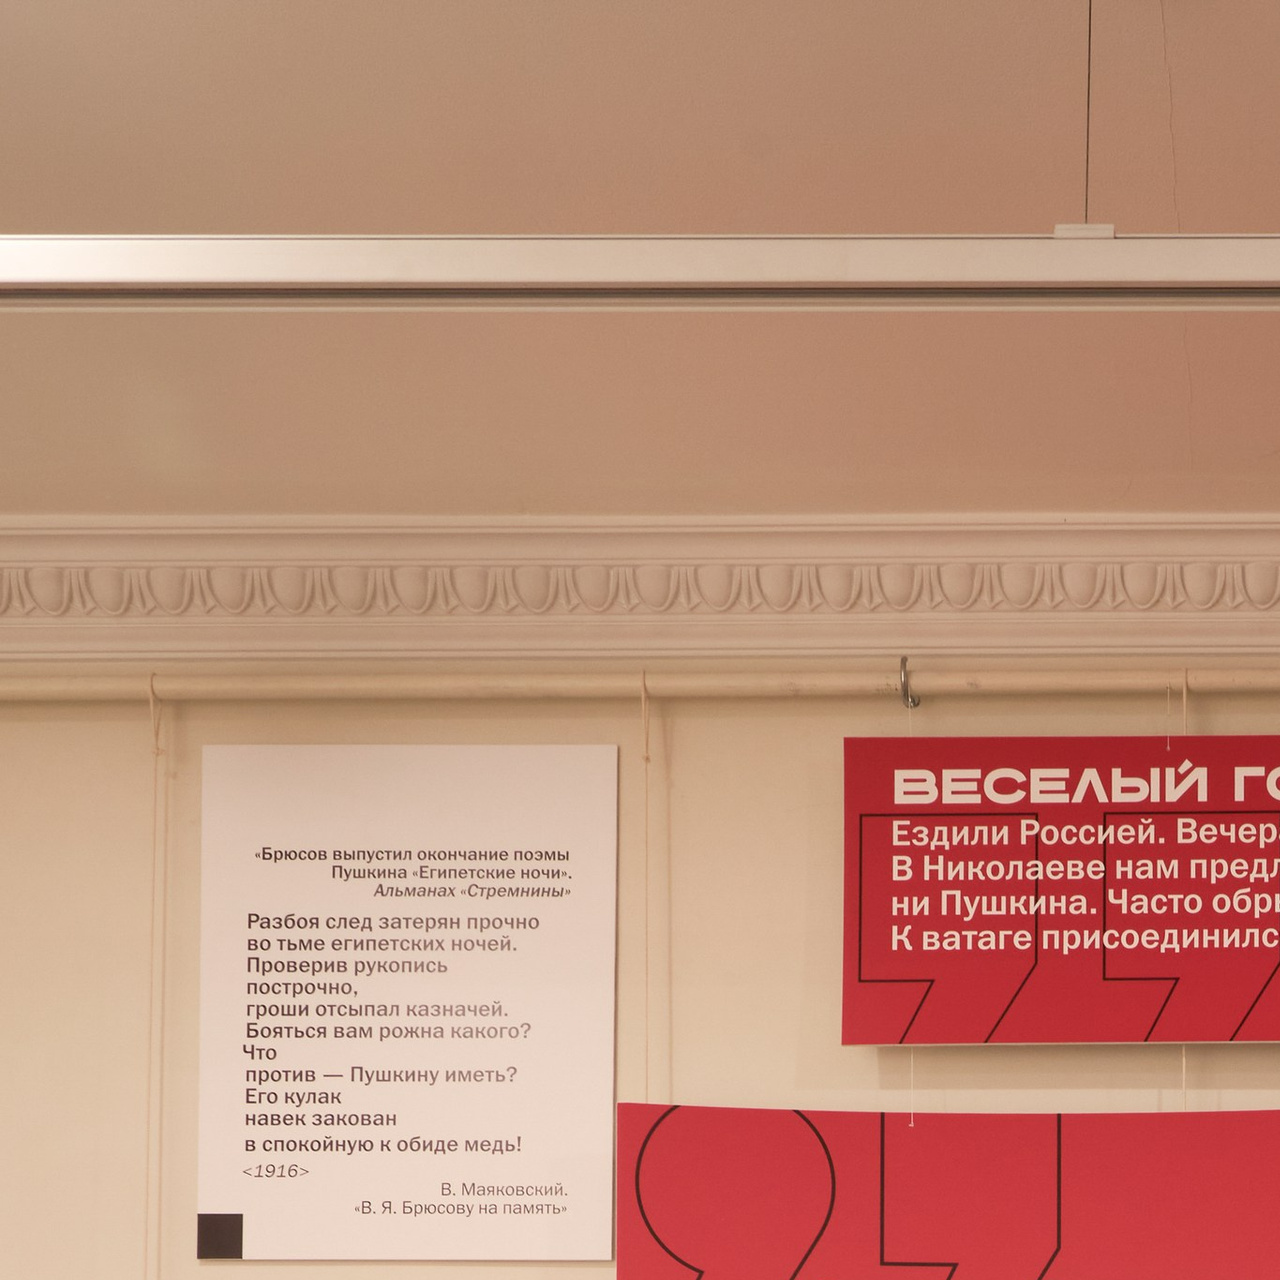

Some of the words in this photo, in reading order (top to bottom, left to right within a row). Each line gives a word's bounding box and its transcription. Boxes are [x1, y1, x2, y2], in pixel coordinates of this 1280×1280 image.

[893, 759, 1208, 805] ВЕСЕЛЫЙ
[892, 820, 1009, 851] Ездили
[1020, 818, 1165, 845] Россией.
[254, 846, 328, 864] «Брюсов
[332, 849, 412, 864] выпустил
[417, 850, 509, 861] окончание
[513, 850, 569, 861] поэмы
[247, 913, 319, 930] Разбоя
[325, 916, 373, 933] след
[378, 916, 461, 933] затерян
[467, 917, 540, 933] прочно
[891, 925, 913, 951] К
[922, 929, 1032, 951] ватаге
[247, 956, 348, 977] Проверив
[354, 960, 448, 977] рукопись
[247, 982, 358, 999] построчно,
[242, 1044, 277, 1061] Что
[245, 1087, 279, 1105] Его
[284, 1091, 342, 1108] кулак
[242, 1163, 309, 1179] <1916>
